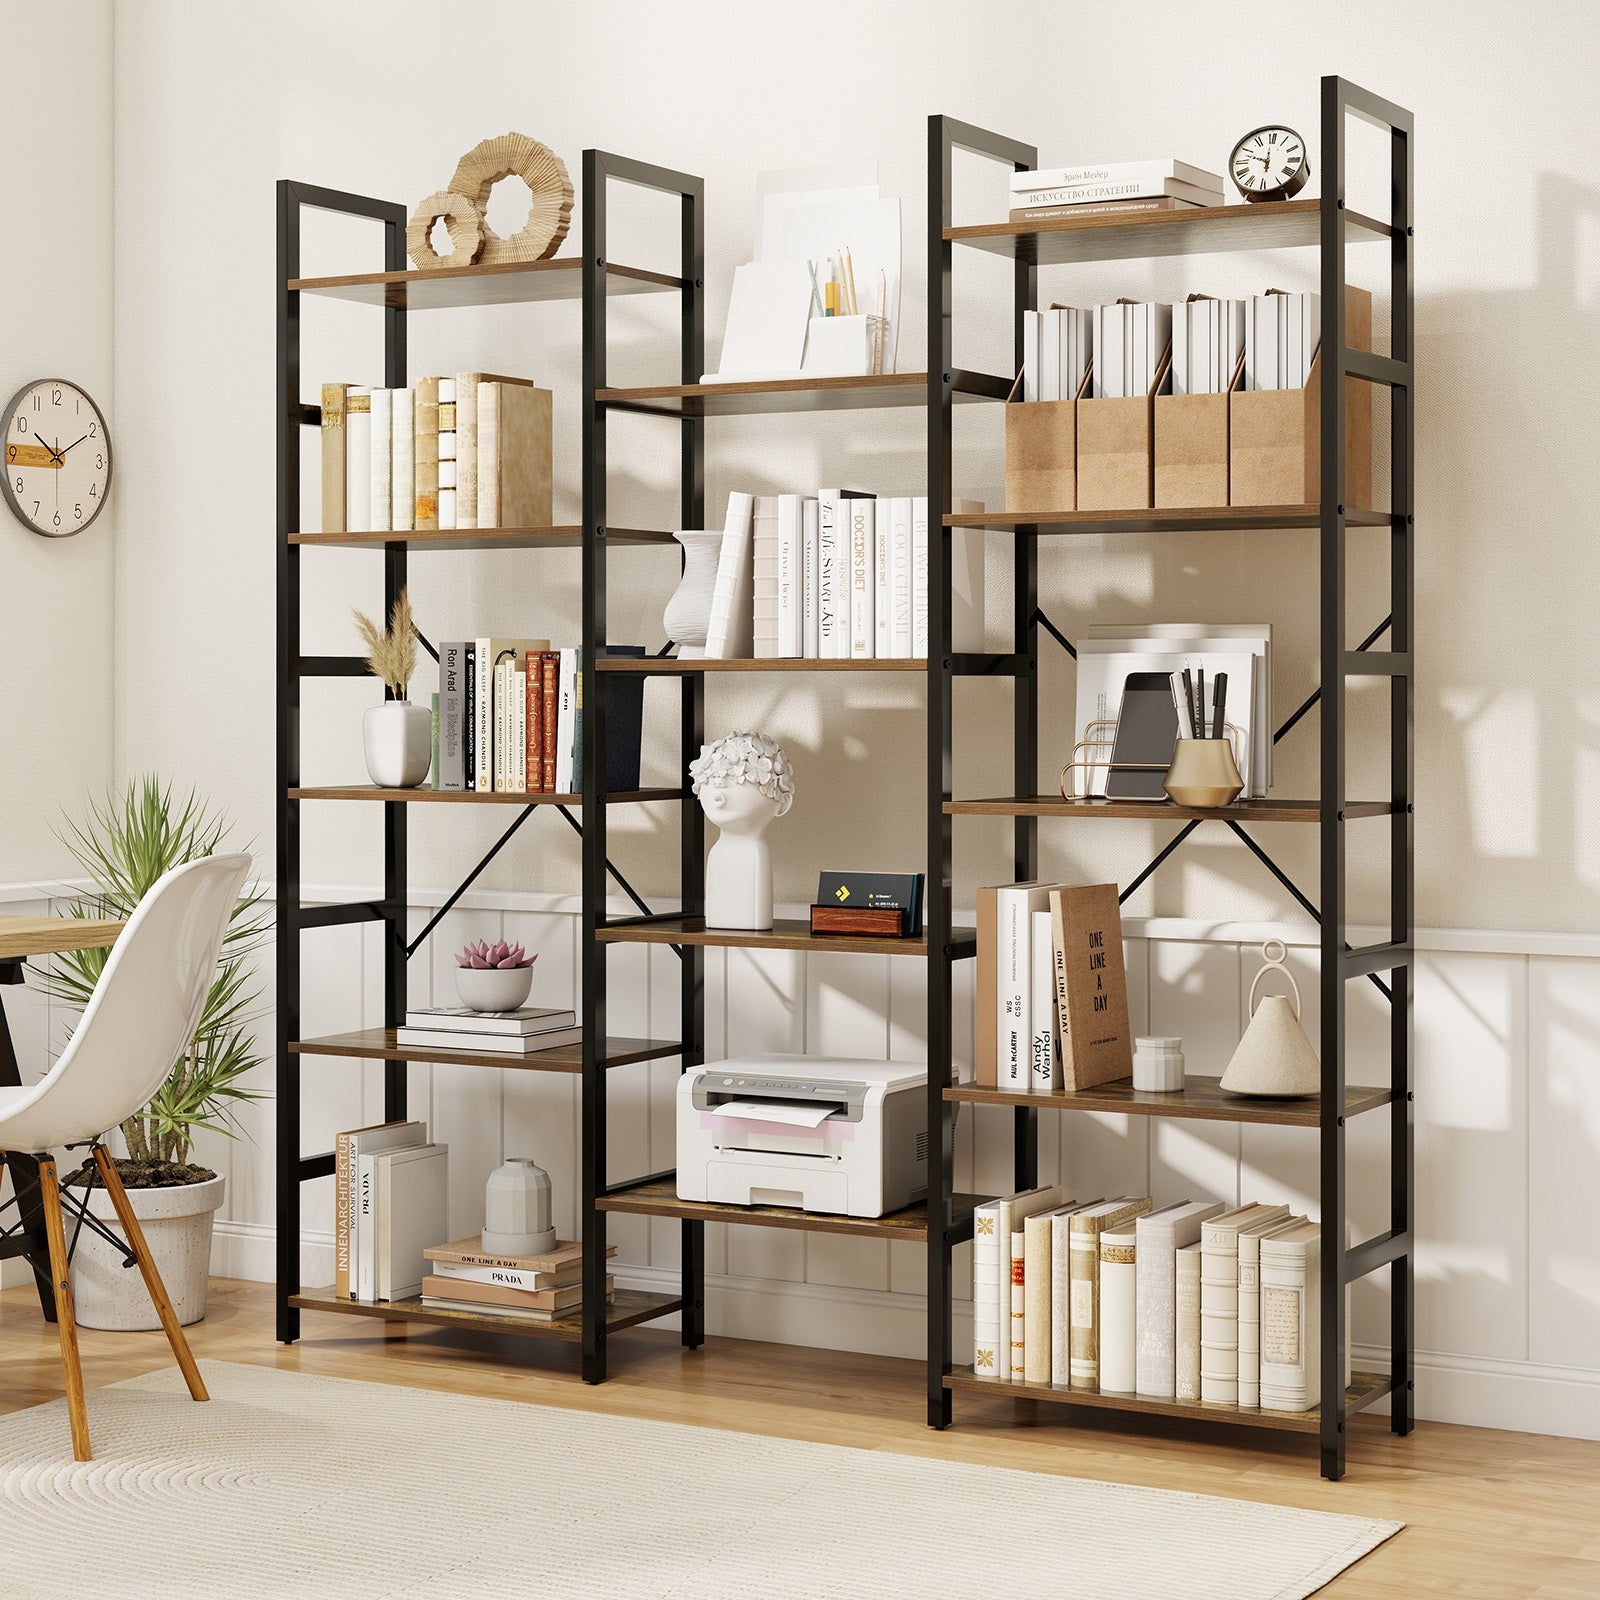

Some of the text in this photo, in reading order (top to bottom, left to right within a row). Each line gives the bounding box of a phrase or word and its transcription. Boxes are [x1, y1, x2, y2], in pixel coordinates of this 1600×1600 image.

[1063, 170, 1109, 182] Эрин Мейер
[1029, 184, 1140, 203] ИСКУССТВО СТРАТЕГИИ
[34, 396, 40, 411] 11
[52, 390, 62, 406] 12
[17, 416, 27, 433] 10
[89, 422, 96, 438] 2
[9, 446, 17, 462] 9
[96, 454, 102, 470] 3
[16, 477, 24, 493] 8
[89, 483, 96, 498] 4
[34, 500, 40, 516] 7
[74, 504, 82, 519] 5
[53, 510, 61, 526] 6
[855, 569, 866, 592] DIET
[895, 574, 909, 639] CHANEL
[447, 649, 458, 668] Ron
[447, 670, 458, 692] Arad
[1089, 931, 1103, 948] ONE
[1056, 950, 1064, 972] ONE
[1089, 952, 1106, 970] LINE
[1058, 976, 1066, 1000] LINE
[1097, 974, 1102, 990] A
[1006, 1000, 1012, 1014] WS
[1094, 994, 1108, 1012] DAY
[1033, 1036, 1044, 1073] Andy
[1042, 1030, 1050, 1080] Warhol
[362, 1172, 370, 1214] PRADA
[338, 1134, 348, 1272] INNENARCHITEKTUR
[492, 1272, 522, 1284] PRADA
